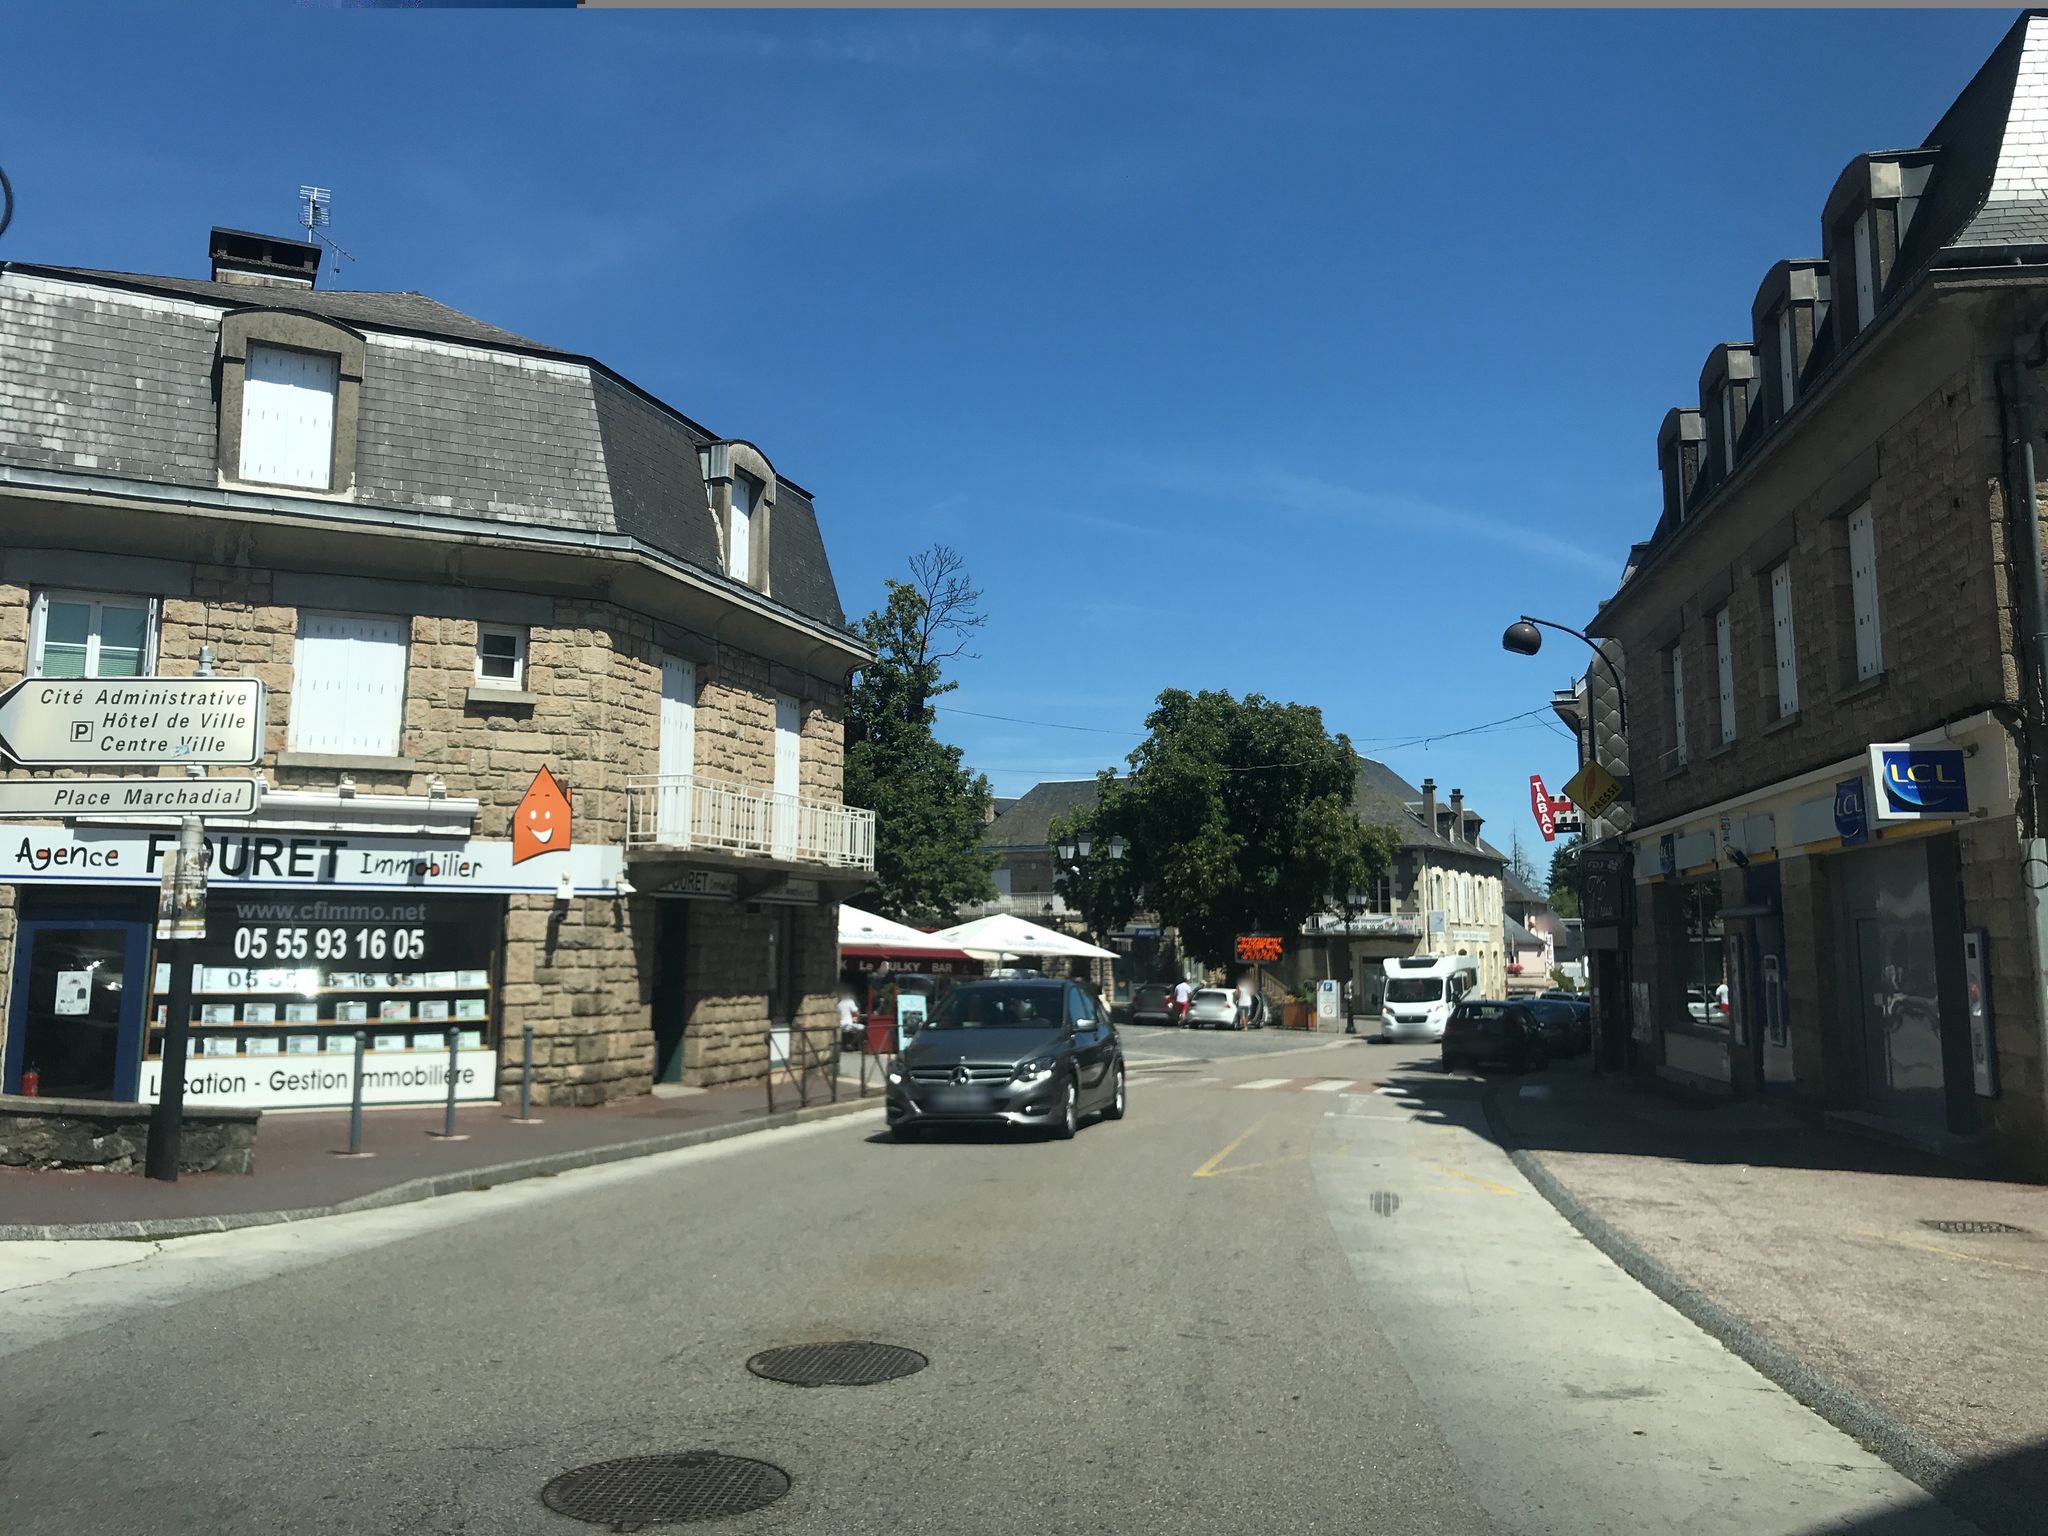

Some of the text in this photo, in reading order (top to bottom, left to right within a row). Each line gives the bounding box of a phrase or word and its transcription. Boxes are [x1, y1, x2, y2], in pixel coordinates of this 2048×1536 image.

[40, 688, 247, 706] Cité Administrative
[103, 712, 246, 729] Hôtel de Ville
[101, 735, 226, 752] Centre Ville
[1890, 763, 1957, 783] LCL
[54, 788, 242, 806] Place Marchadial
[1590, 783, 1620, 814] PRESSE
[1836, 794, 1863, 816] LCL
[1532, 781, 1553, 834] TABAC
[16, 837, 119, 871] Agence
[360, 852, 483, 879] Immobilier
[670, 871, 709, 891] OURET
[237, 901, 427, 921] www.cfimmo.net
[234, 926, 425, 960] 05 55 93 16 05
[859, 960, 874, 970] Le
[931, 962, 953, 972] BAR
[150, 1072, 245, 1096] Lation
[269, 1070, 348, 1092] Gestion
[358, 1065, 475, 1088] mmobilire
